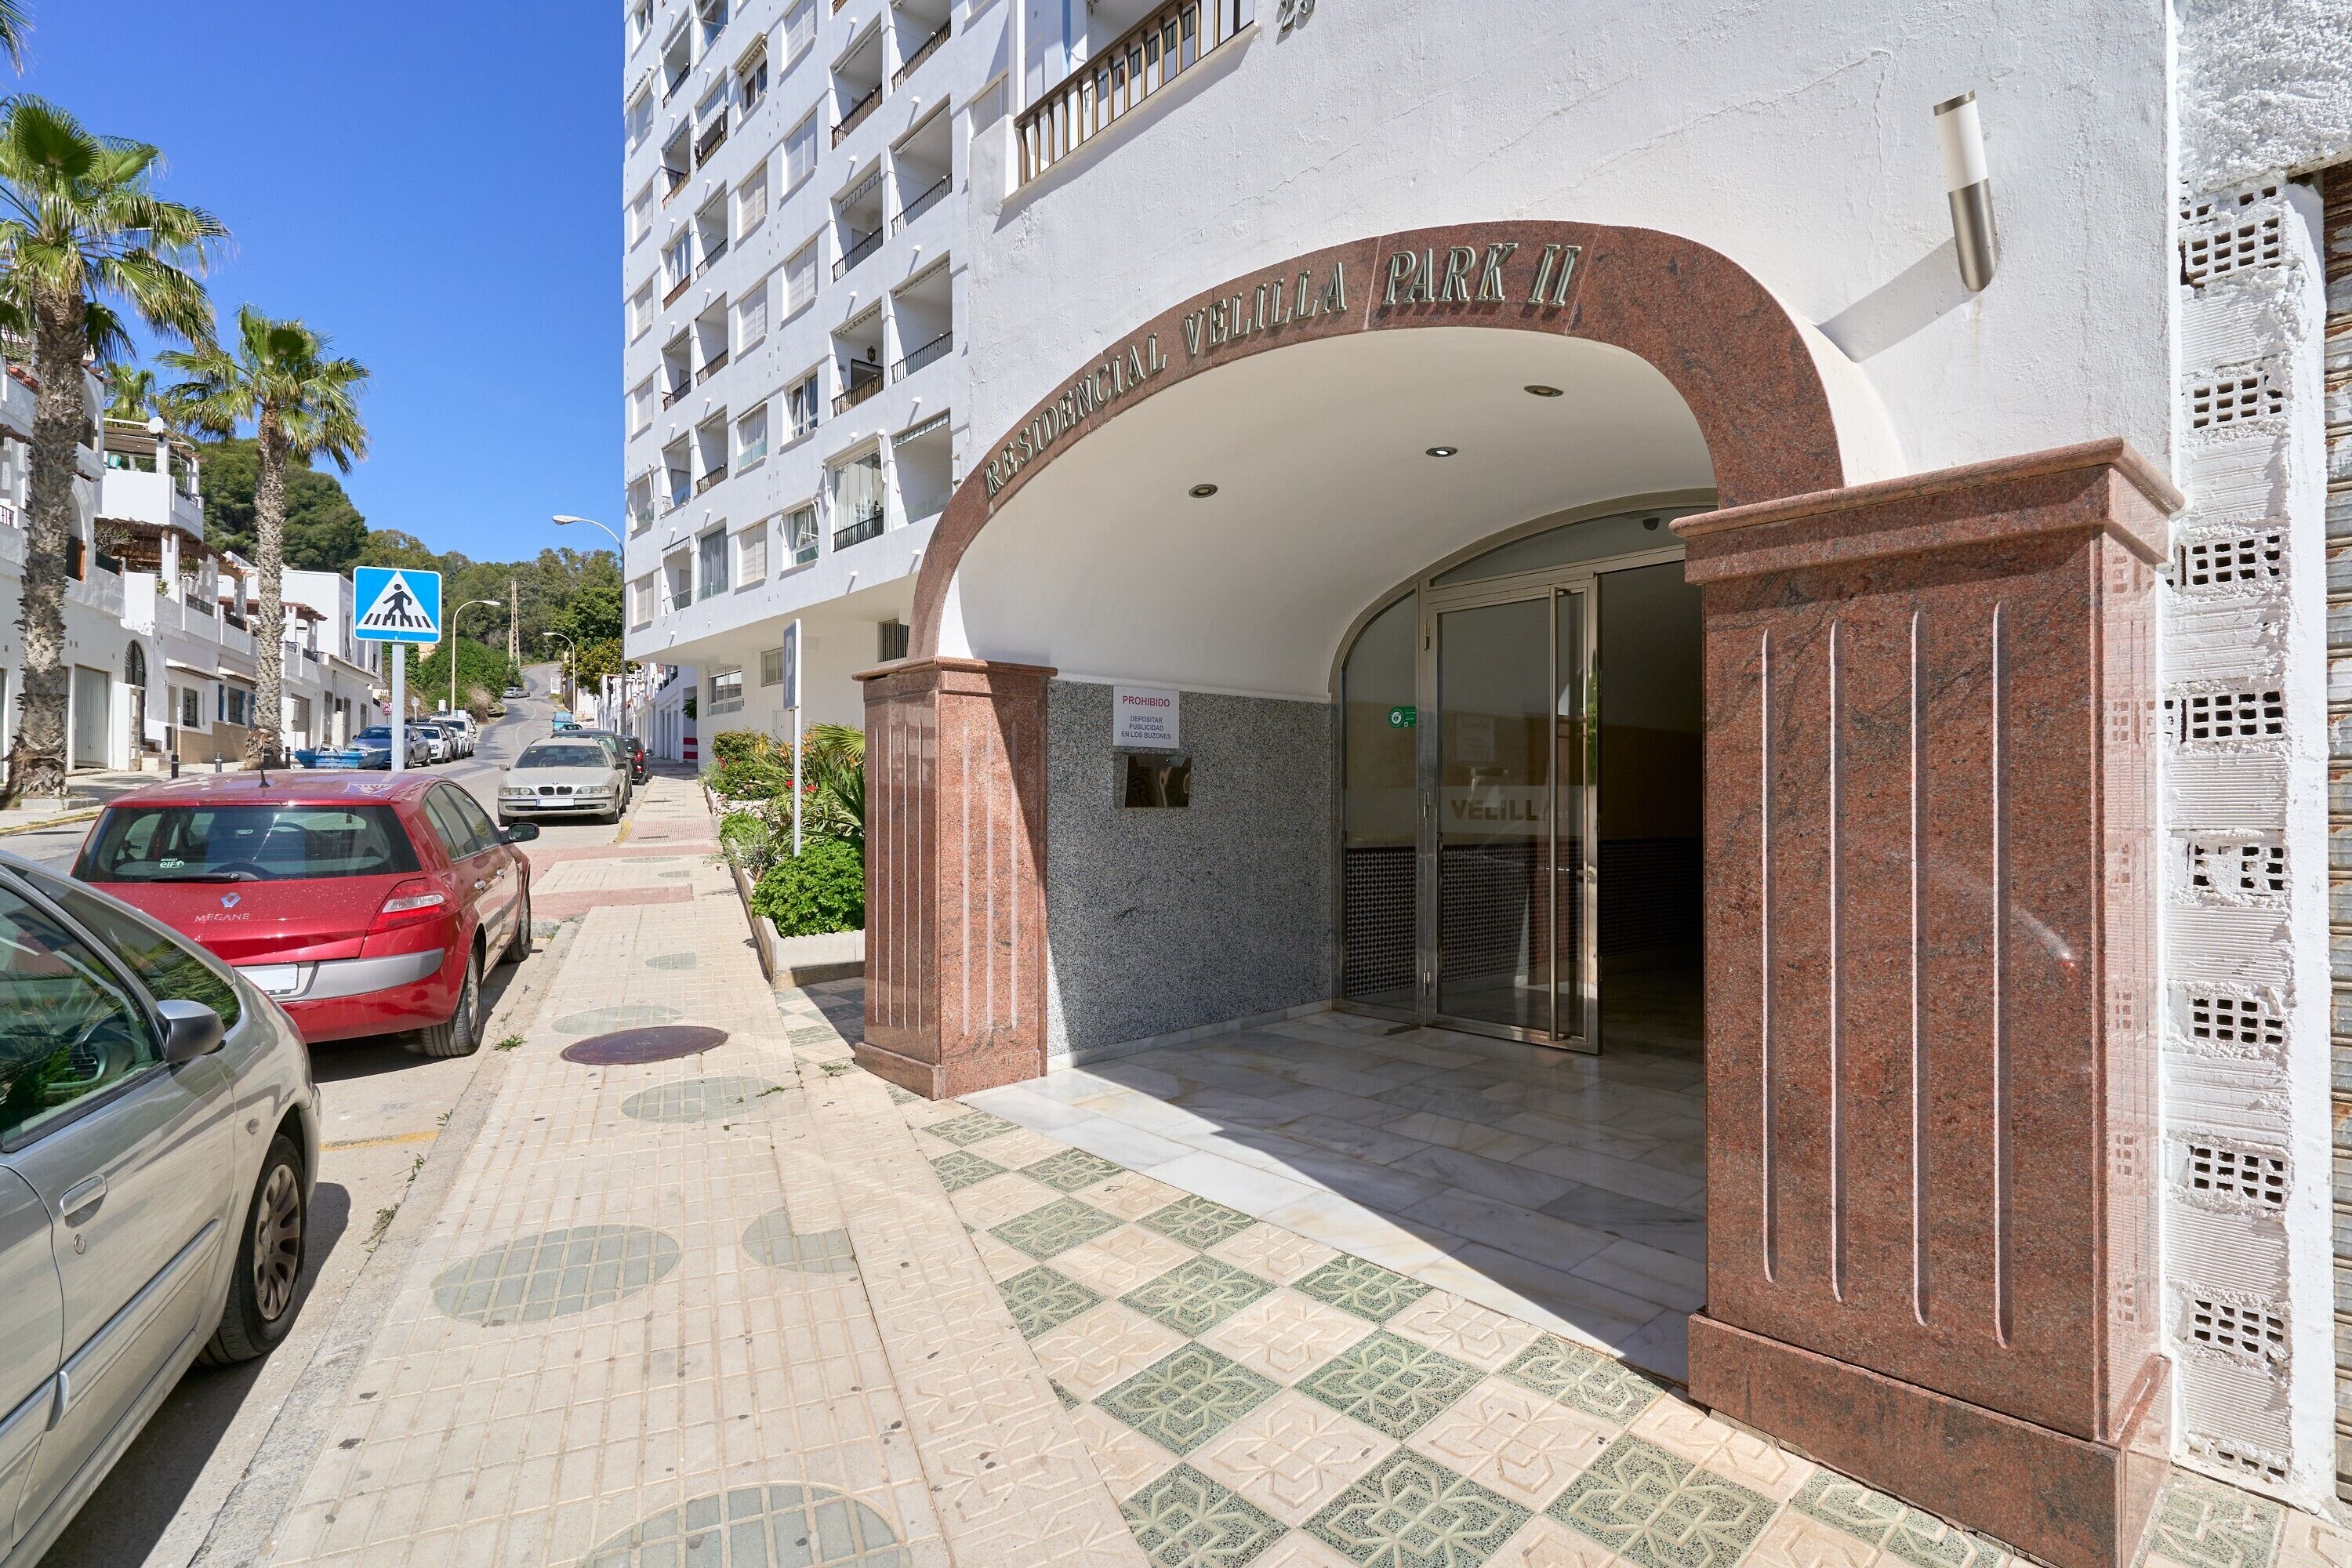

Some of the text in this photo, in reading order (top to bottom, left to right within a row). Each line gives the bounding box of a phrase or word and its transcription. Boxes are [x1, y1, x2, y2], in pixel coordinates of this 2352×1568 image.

[985, 242, 1582, 498] RESIDENCIAL VELILLA PARK II
[1122, 695, 1171, 707] PROHIBIDO
[194, 913, 250, 922] MEGANE
